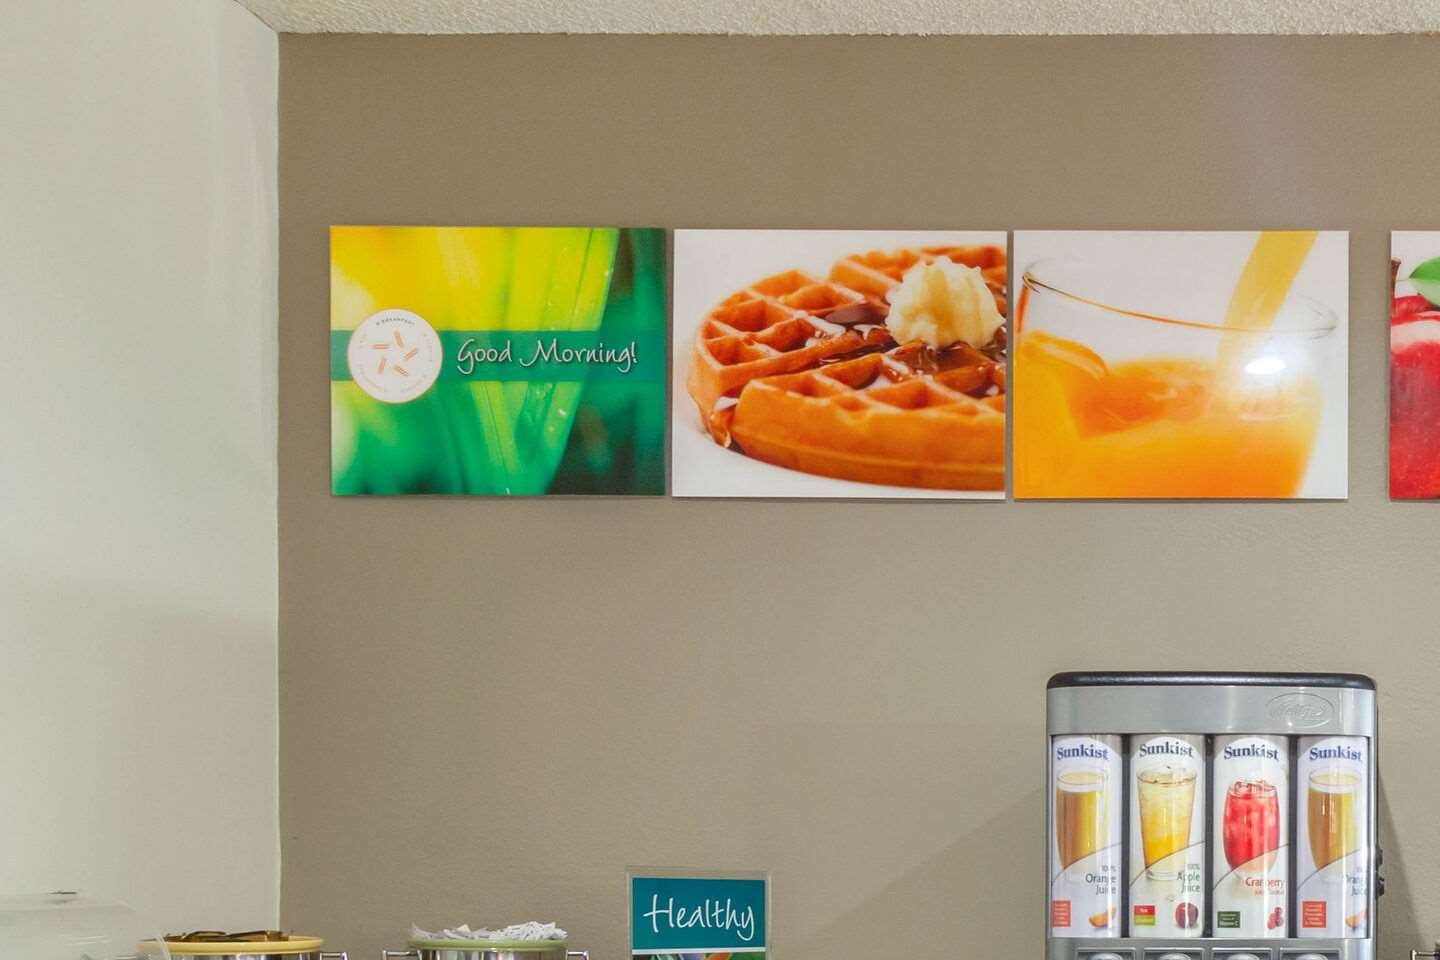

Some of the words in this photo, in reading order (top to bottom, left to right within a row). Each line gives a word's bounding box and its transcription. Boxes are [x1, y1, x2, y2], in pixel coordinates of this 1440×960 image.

[456, 338, 513, 375] Good
[519, 338, 638, 373] Morning!
[1056, 743, 1110, 761] Sunkist
[1138, 741, 1194, 758] Sunkist
[1223, 743, 1280, 762] Sunkist
[1308, 745, 1363, 763] Sunkist
[1085, 873, 1117, 885] Orane
[1095, 885, 1117, 896] Juie
[642, 893, 756, 942] Healthy
